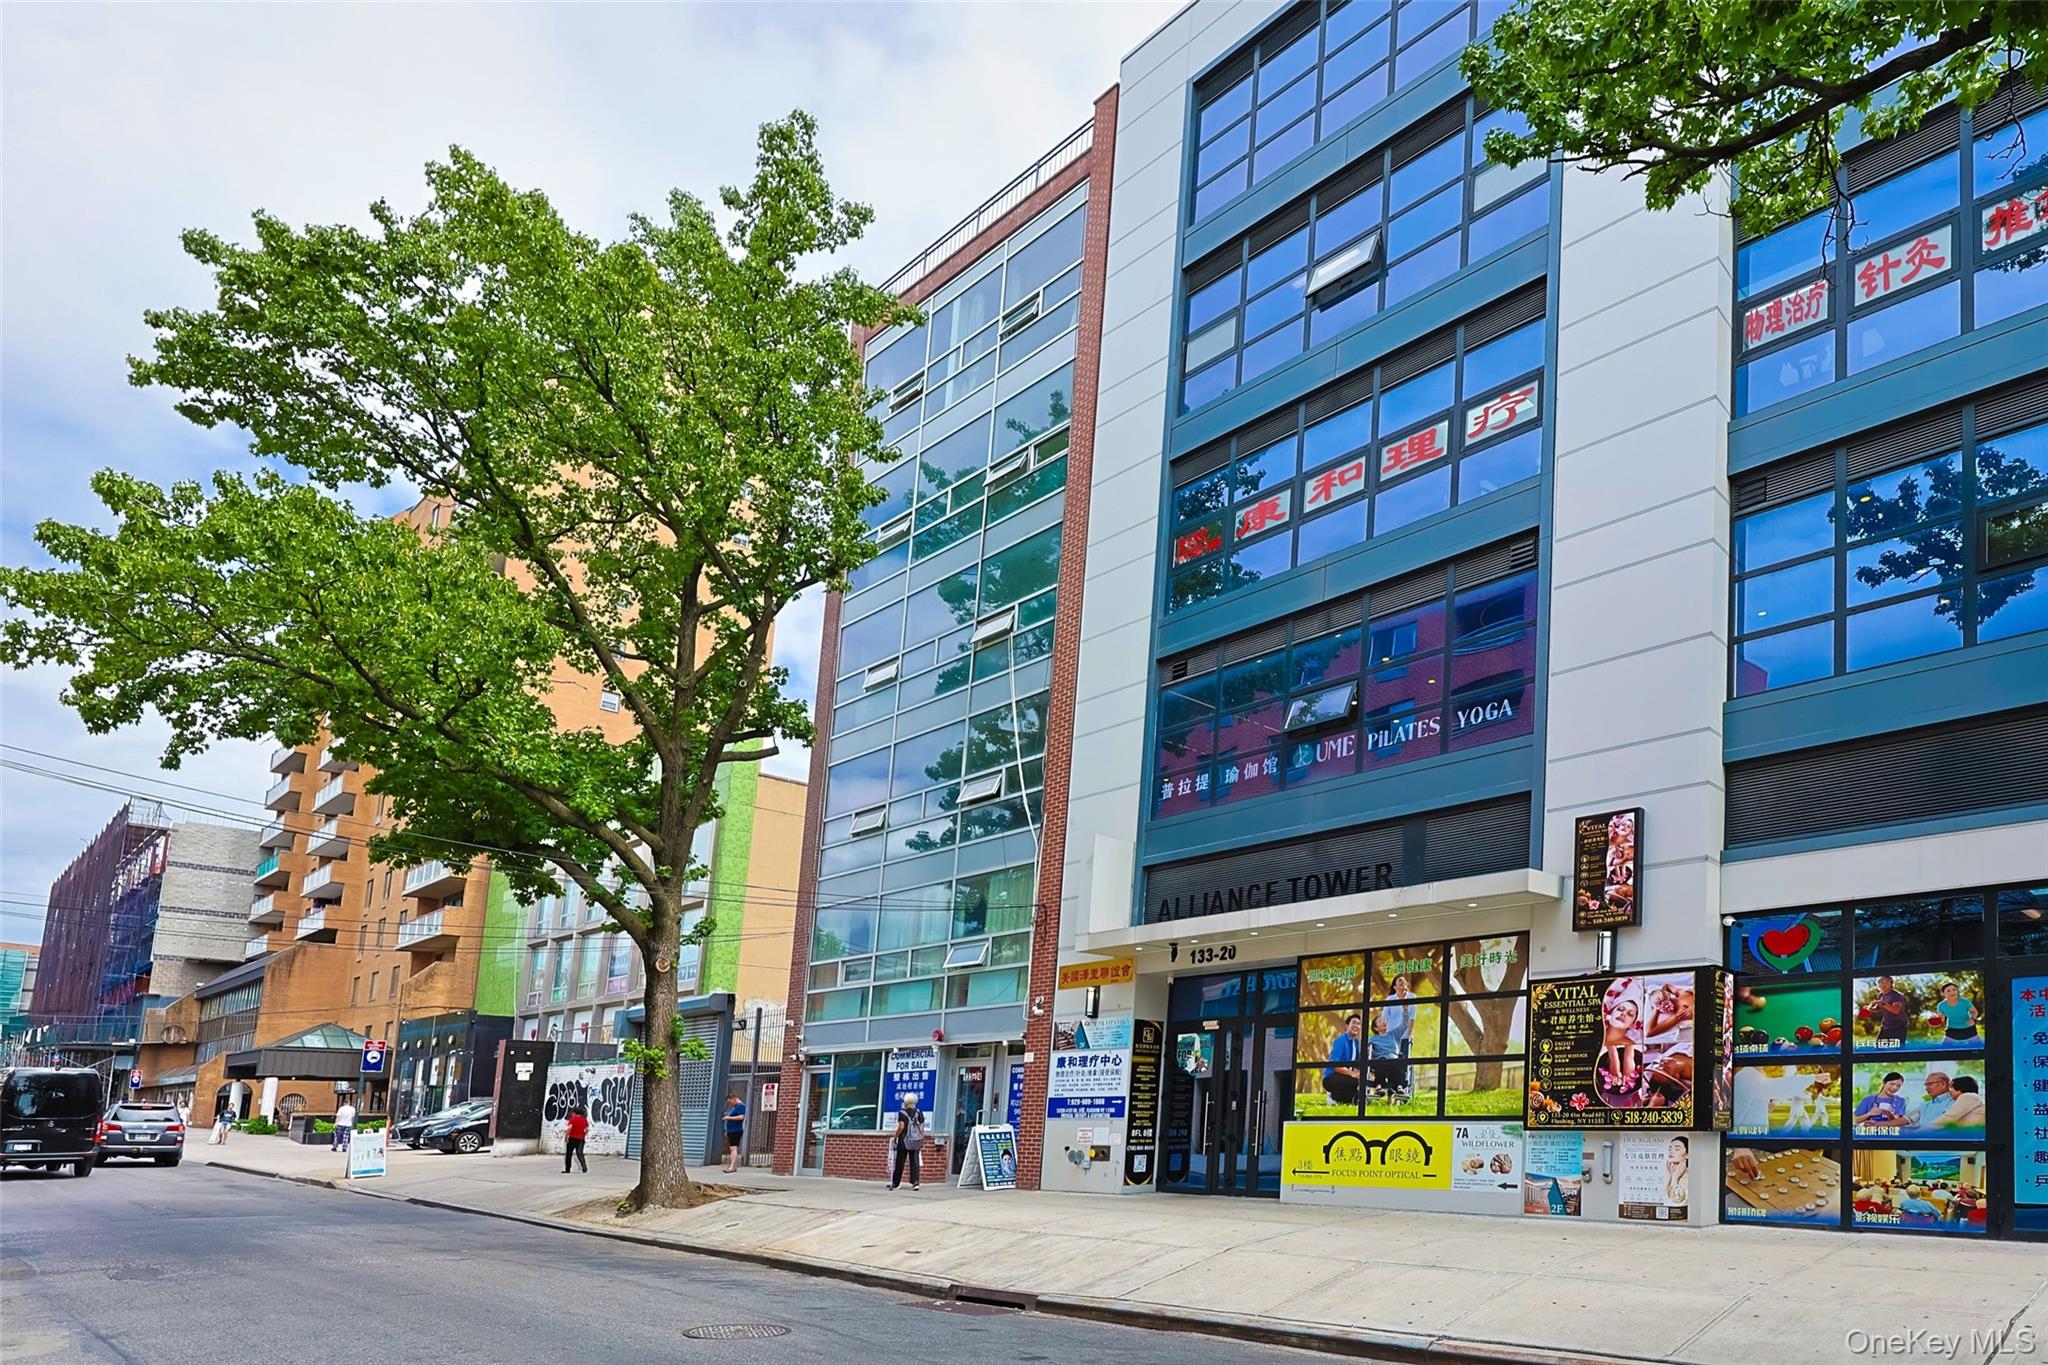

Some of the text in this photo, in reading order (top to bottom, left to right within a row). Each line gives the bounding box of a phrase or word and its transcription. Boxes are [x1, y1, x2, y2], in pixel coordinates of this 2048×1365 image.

[1745, 280, 1826, 343] 物理治疗
[1856, 236, 1946, 298] 针灸
[1456, 698, 1513, 728] YOGA
[1160, 755, 1279, 801] 普拉提 瑜伽馆
[1156, 862, 1394, 923] ALLIANCE TOWER
[1190, 945, 1236, 964] 133-20
[1460, 949, 1518, 968] 美好時光
[1553, 985, 1599, 1000] VITAL
[1543, 998, 1602, 1009] ESSENTIAL SPA
[1856, 1039, 1901, 1049] 乒乓运动
[891, 1049, 934, 1060] COMMERCIAL
[1056, 1054, 1122, 1068] 康和理疗中心
[896, 1060, 927, 1070] FOR SALE
[1624, 1111, 1684, 1124] 518-240-5839
[1456, 1128, 1468, 1138] 7A
[1855, 1126, 1901, 1136] 健康保健
[1333, 1147, 1421, 1163] 焦點 眼鏡
[1331, 1169, 1421, 1179] FOCUS POINT OPTICAL
[1551, 1205, 1563, 1213] 2F
[1855, 1212, 1901, 1224] 影视娱乐
